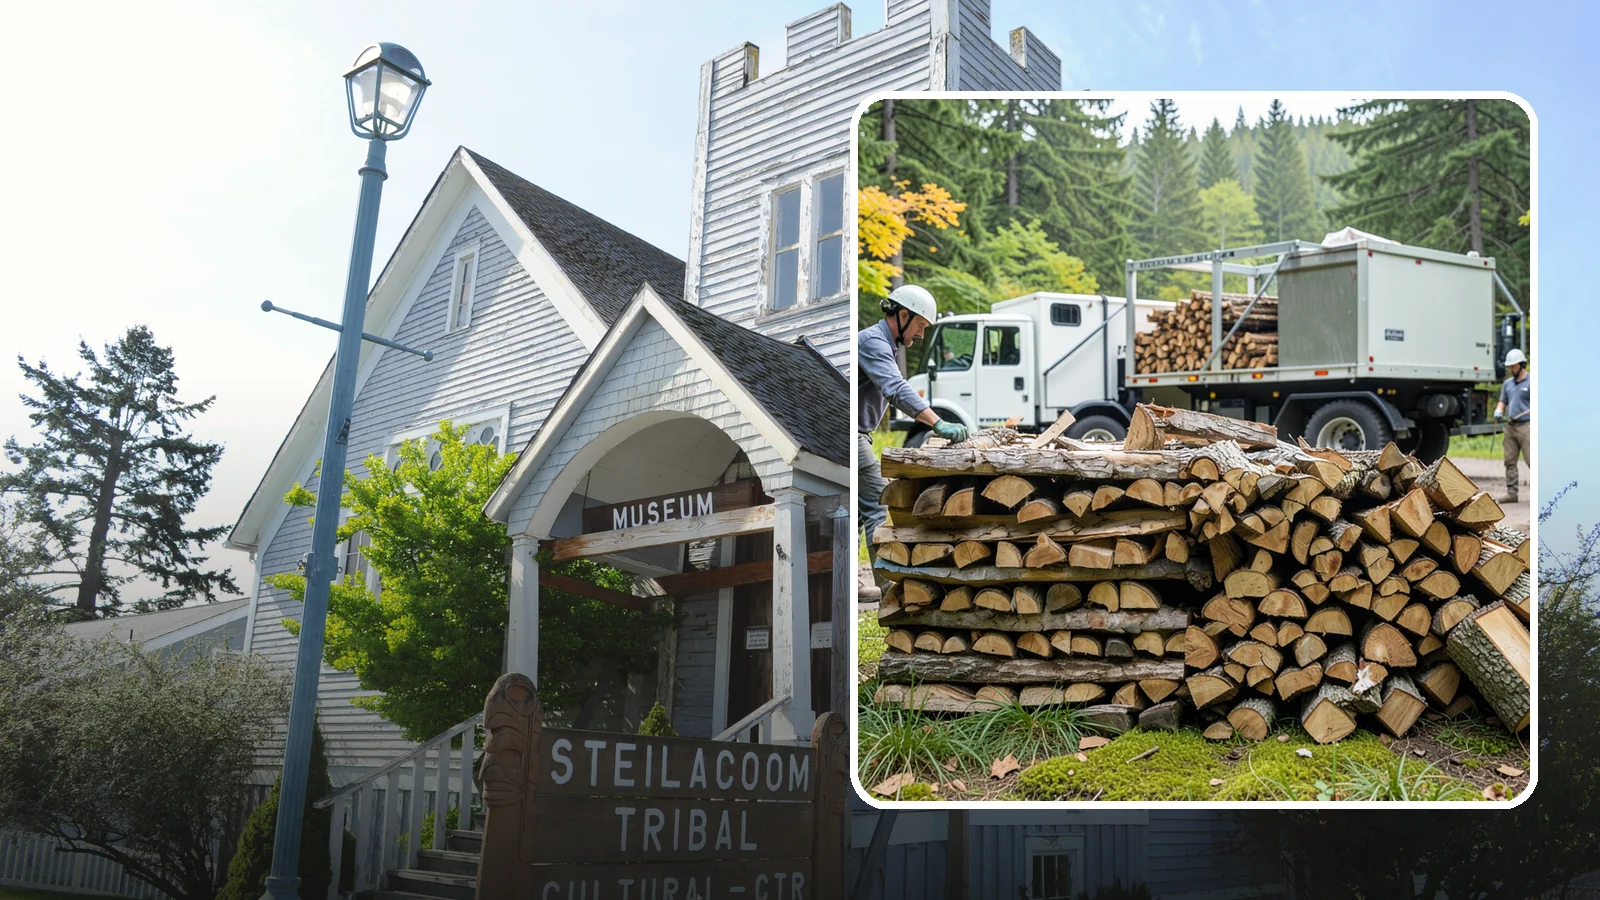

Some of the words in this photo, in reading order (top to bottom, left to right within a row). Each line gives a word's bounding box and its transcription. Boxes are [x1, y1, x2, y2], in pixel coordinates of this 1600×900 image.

[612, 491, 714, 531] MUSEUM
[550, 738, 809, 792] STEILACOOM
[614, 807, 758, 852] TRIBAL
